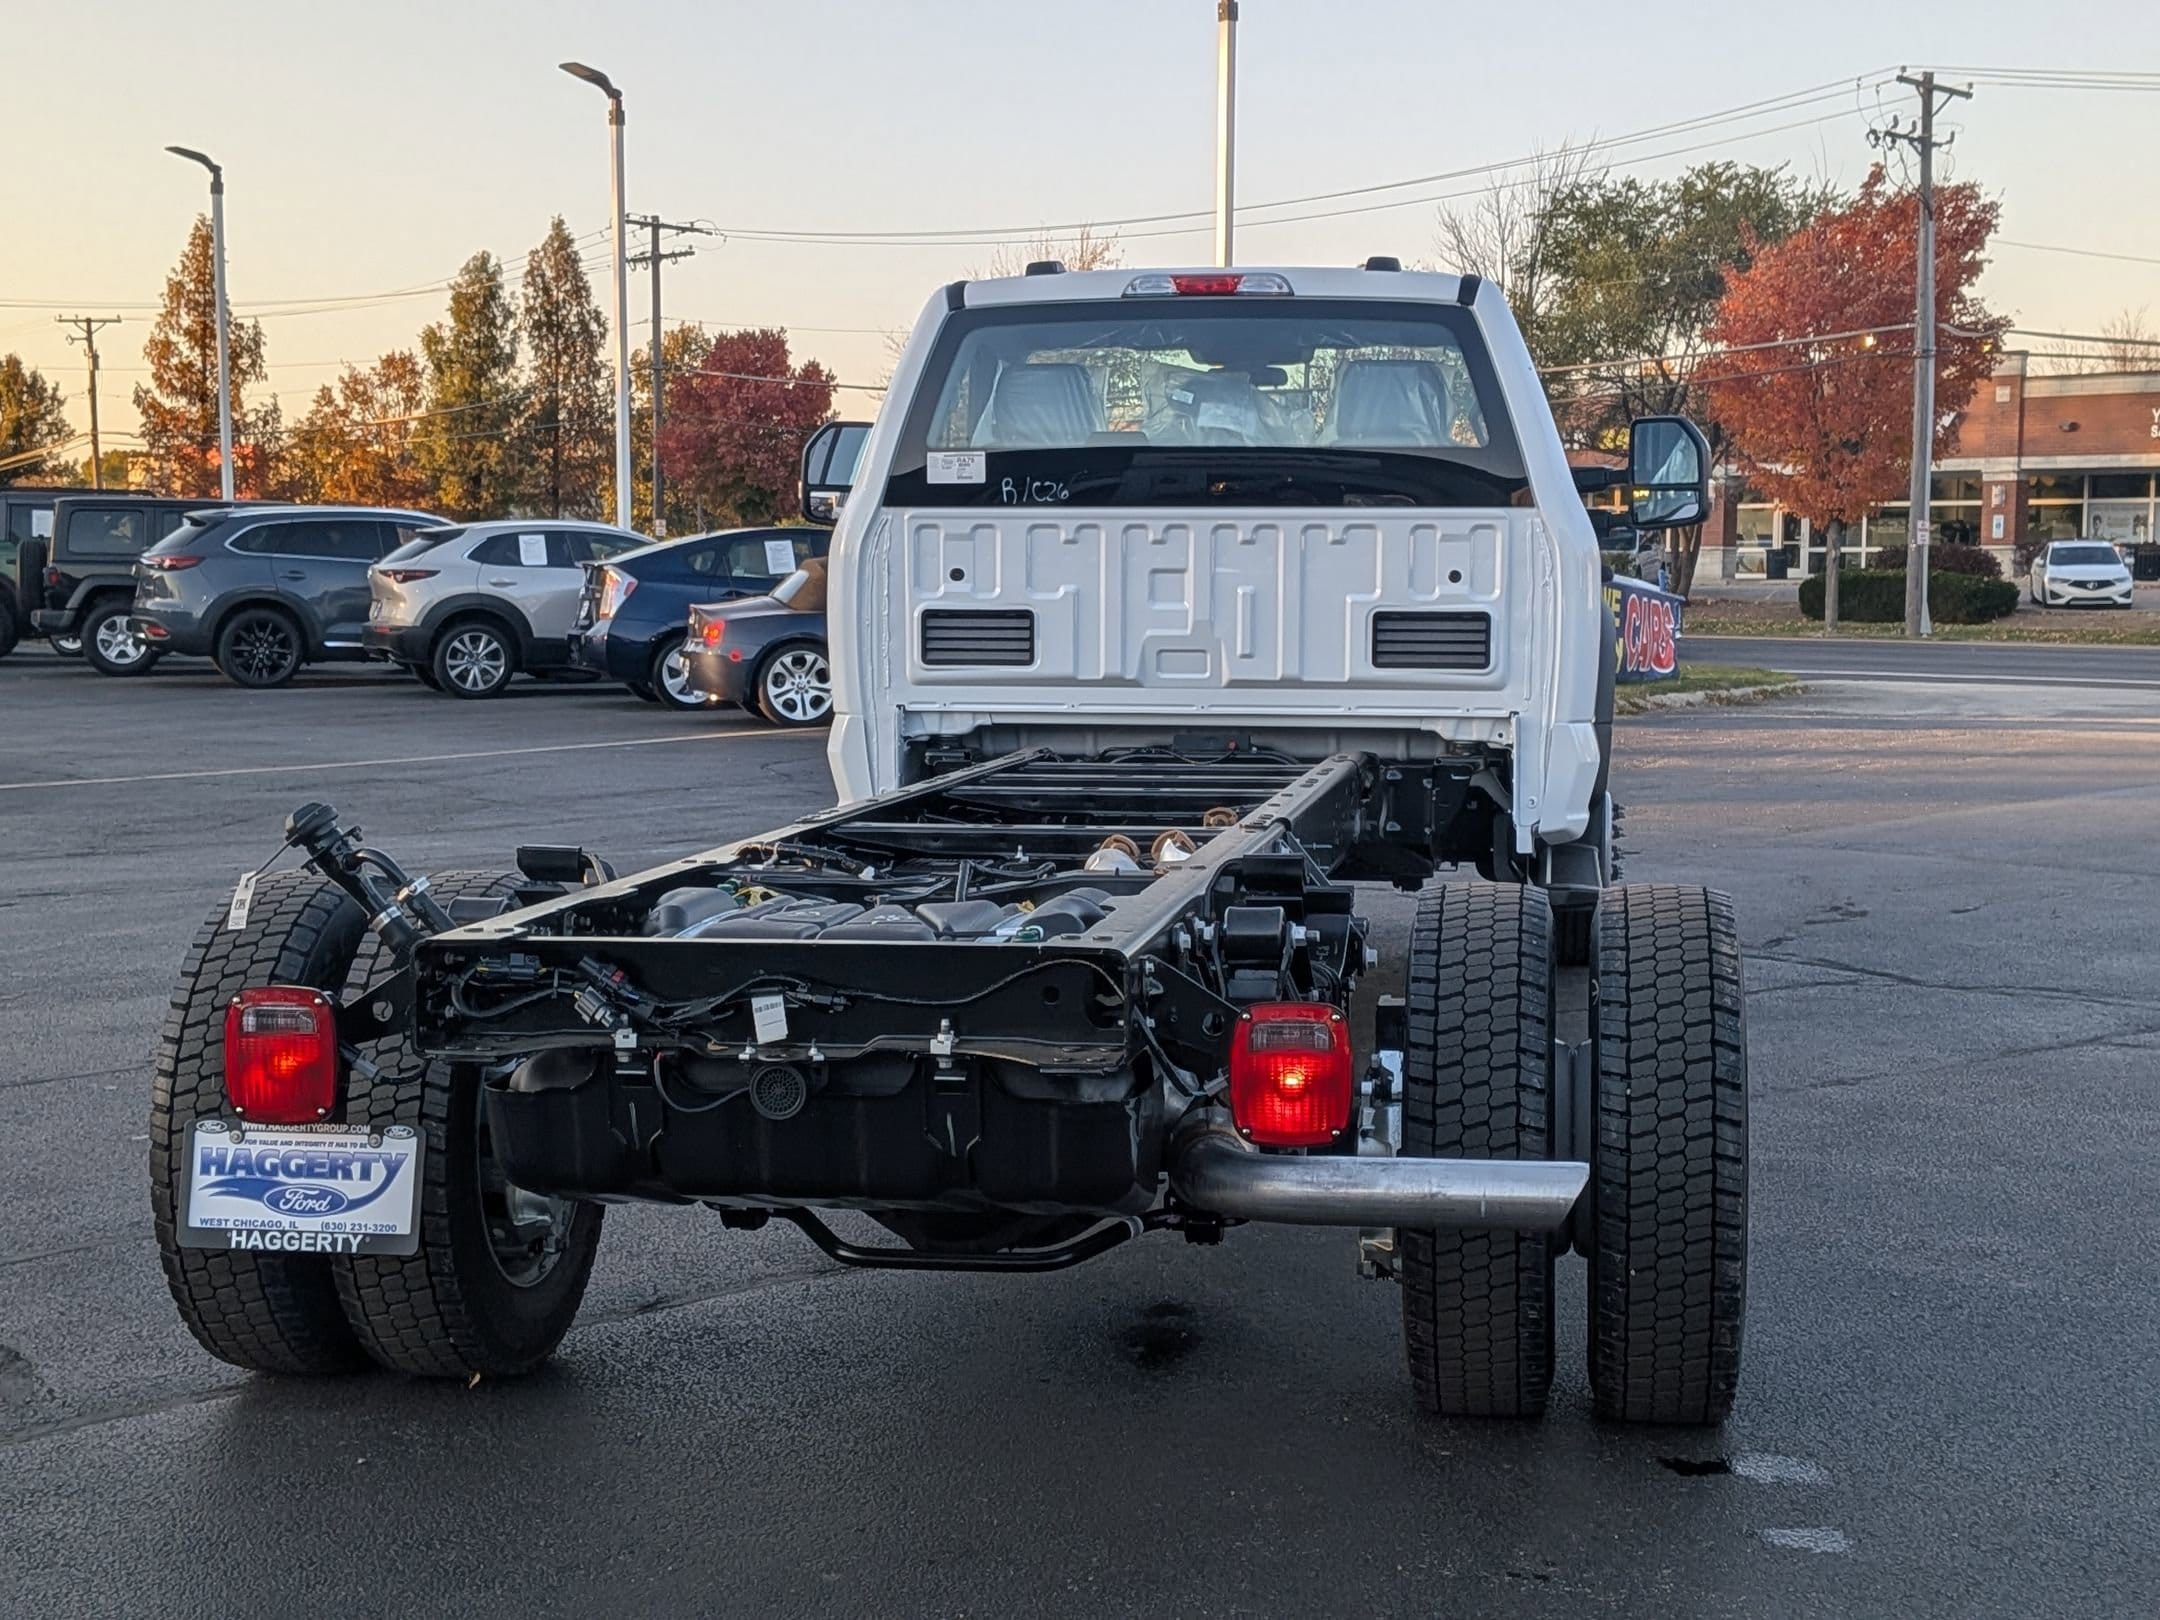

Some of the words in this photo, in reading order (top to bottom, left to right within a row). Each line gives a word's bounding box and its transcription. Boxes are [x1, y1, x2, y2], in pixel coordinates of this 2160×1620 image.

[1625, 593, 1675, 673] CARS
[199, 1146, 409, 1184] HAGGERTY
[279, 1188, 332, 1212] Ford
[199, 1217, 230, 1227] WEST
[232, 1218, 286, 1230] CHICAGO,
[289, 1220, 299, 1229] IL
[320, 1221, 347, 1232] (630)
[349, 1222, 398, 1233] 231-3200
[230, 1229, 364, 1254] HAGGERTY
